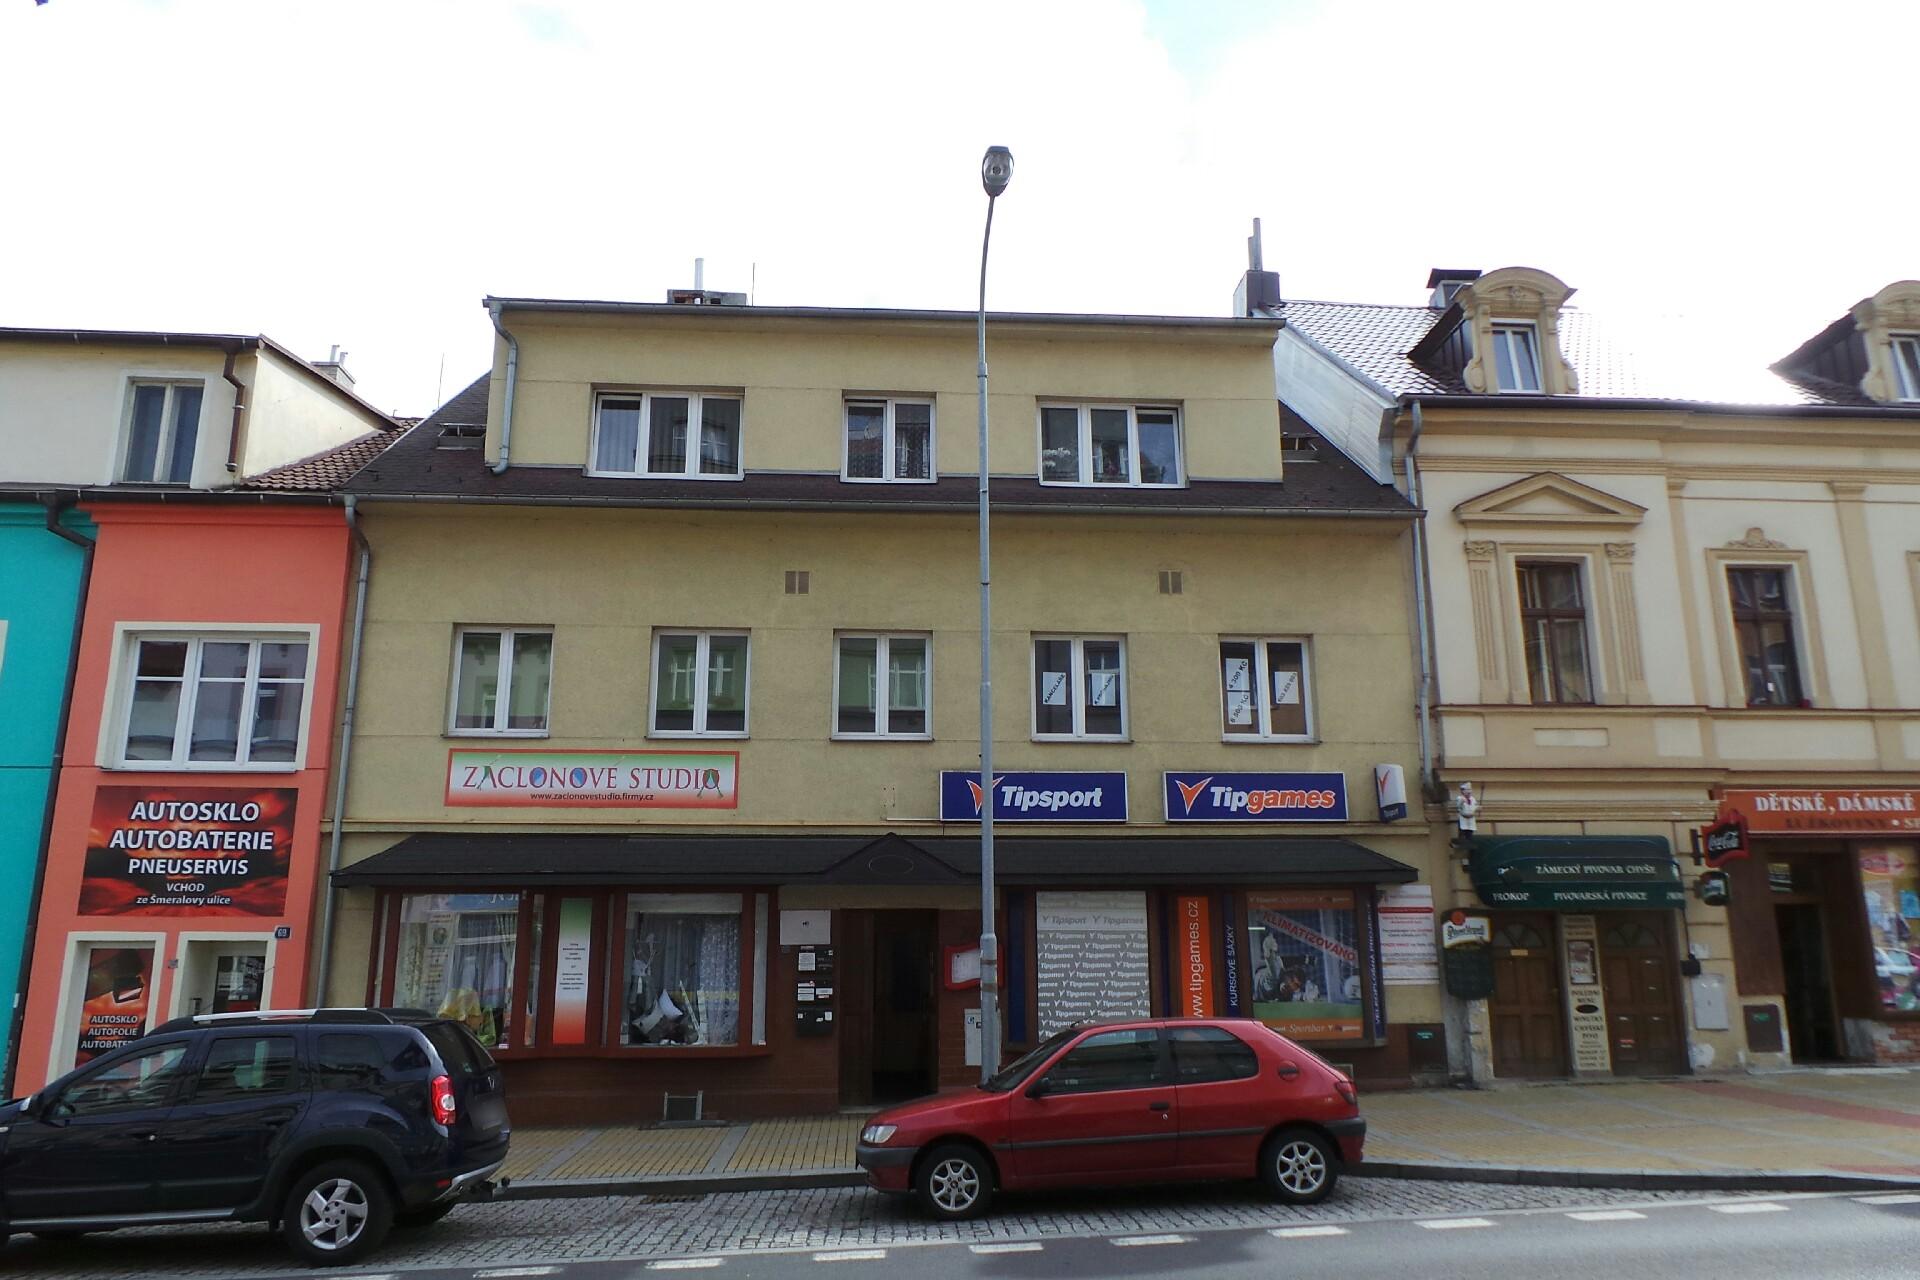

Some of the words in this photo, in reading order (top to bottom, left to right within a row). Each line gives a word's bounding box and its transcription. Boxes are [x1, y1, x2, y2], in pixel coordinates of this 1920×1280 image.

[628, 766, 722, 792] STUDIO
[530, 791, 654, 802] www.zaclonovestudio.firmy.cz
[1000, 786, 1103, 812] Tipsport
[1209, 786, 1336, 814] Tipgames
[1837, 792, 1916, 811] DÁMSKÉ
[130, 801, 260, 822] AUTOSKLO
[109, 829, 275, 850] AUTOBATERIE
[128, 858, 249, 876] PNEUSERVIS
[166, 882, 205, 892] VCHOD
[136, 896, 149, 904] ze
[150, 895, 205, 907] Šmeralovy
[206, 896, 231, 905] ulice
[1188, 901, 1205, 1018] ww.tipgames.cz
[91, 1015, 138, 1024] AUTOSKLO
[88, 1027, 138, 1036] AUTOFOLIE
[81, 1040, 133, 1049] AUTOBATE
